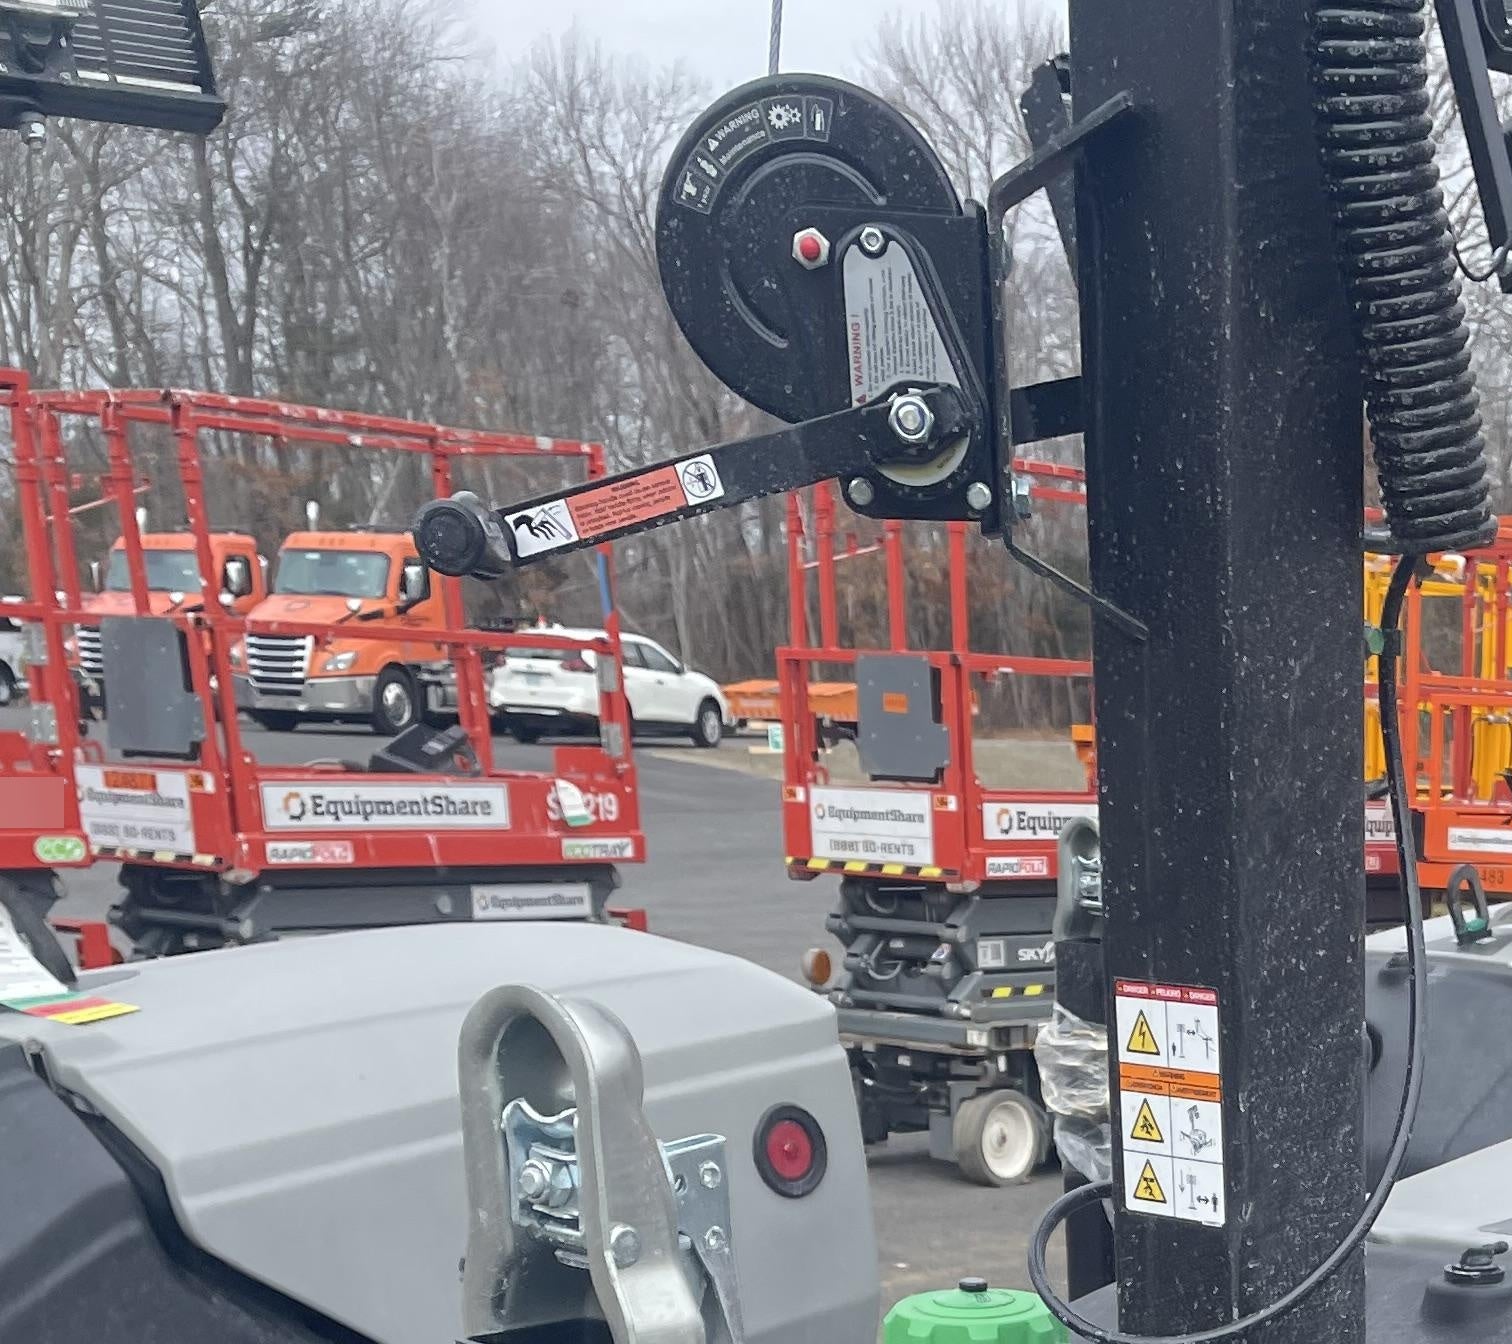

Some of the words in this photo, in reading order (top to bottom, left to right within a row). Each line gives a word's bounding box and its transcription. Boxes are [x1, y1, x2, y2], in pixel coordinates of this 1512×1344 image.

[715, 108, 760, 141] WARNING
[853, 321, 864, 387] WARNING
[311, 794, 491, 821] EquipmentShare
